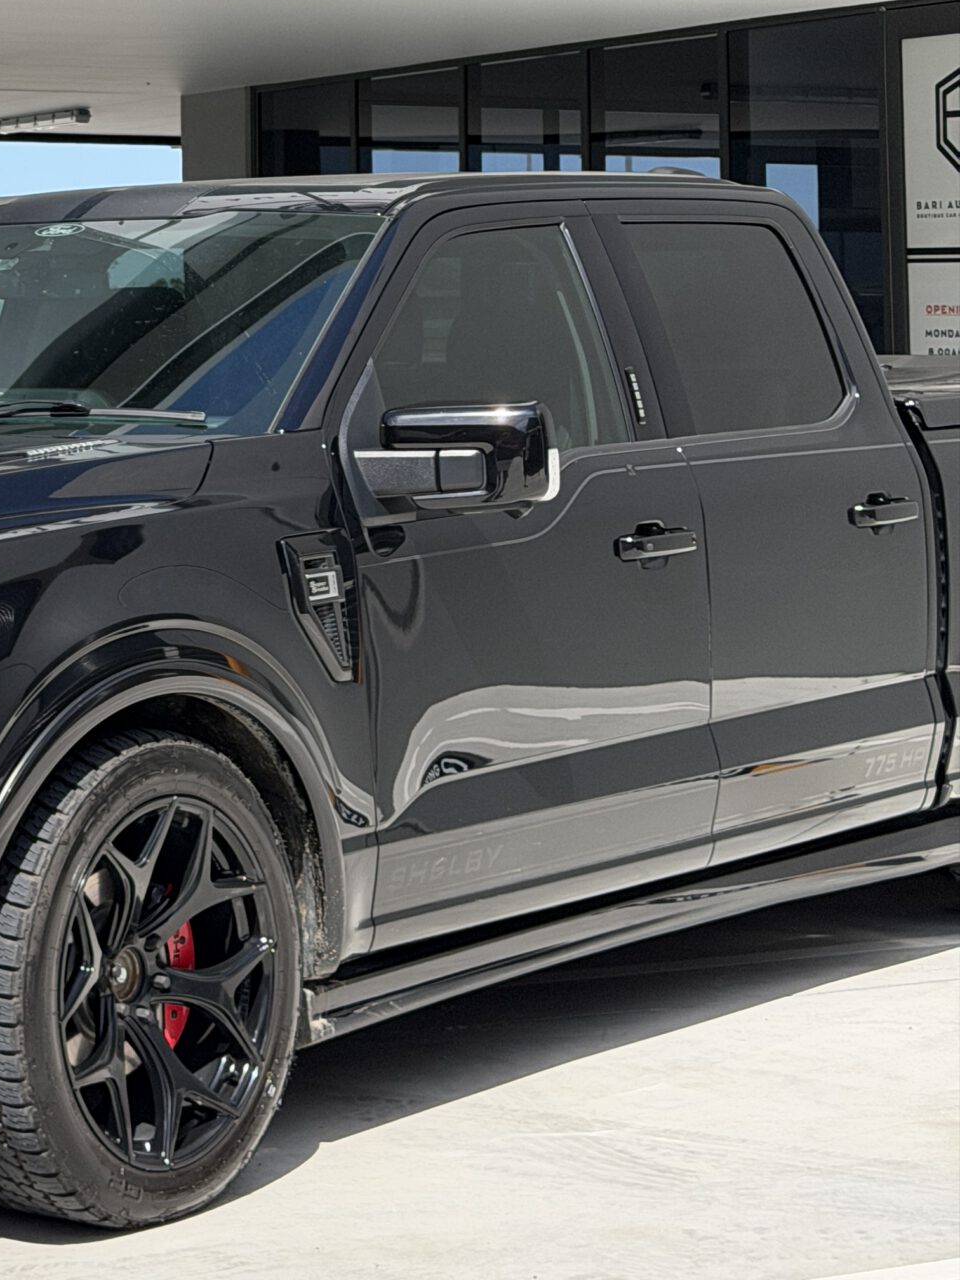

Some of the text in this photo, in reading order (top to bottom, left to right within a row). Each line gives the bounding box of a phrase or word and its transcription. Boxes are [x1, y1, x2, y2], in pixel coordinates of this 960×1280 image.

[916, 200, 942, 210] BARI
[865, 746, 926, 778] 775 HP
[385, 844, 504, 890] SHELBY
